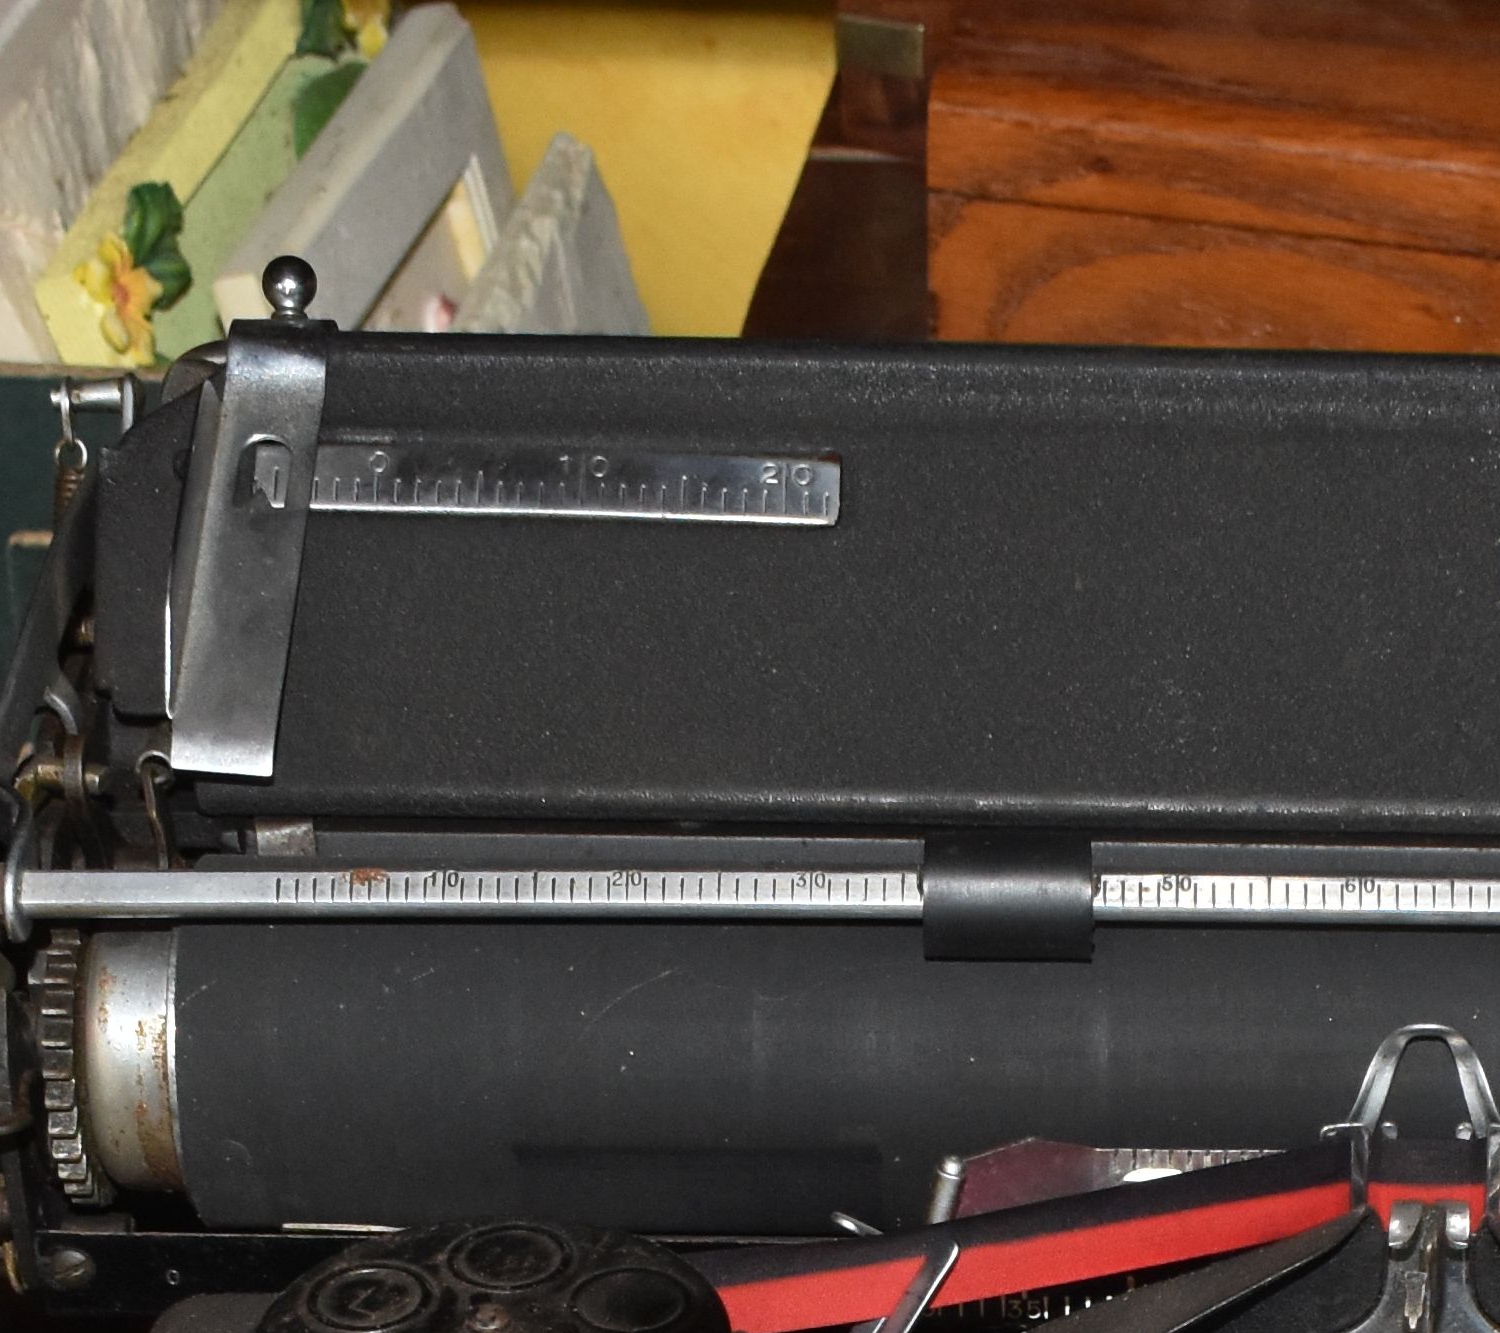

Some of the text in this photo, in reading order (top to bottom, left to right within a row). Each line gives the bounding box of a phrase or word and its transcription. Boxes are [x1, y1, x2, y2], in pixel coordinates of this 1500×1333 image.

[762, 463, 813, 485] 20
[612, 872, 642, 887] 20
[796, 872, 826, 888] 30
[1161, 876, 1192, 891] 50
[1345, 879, 1376, 894] 60
